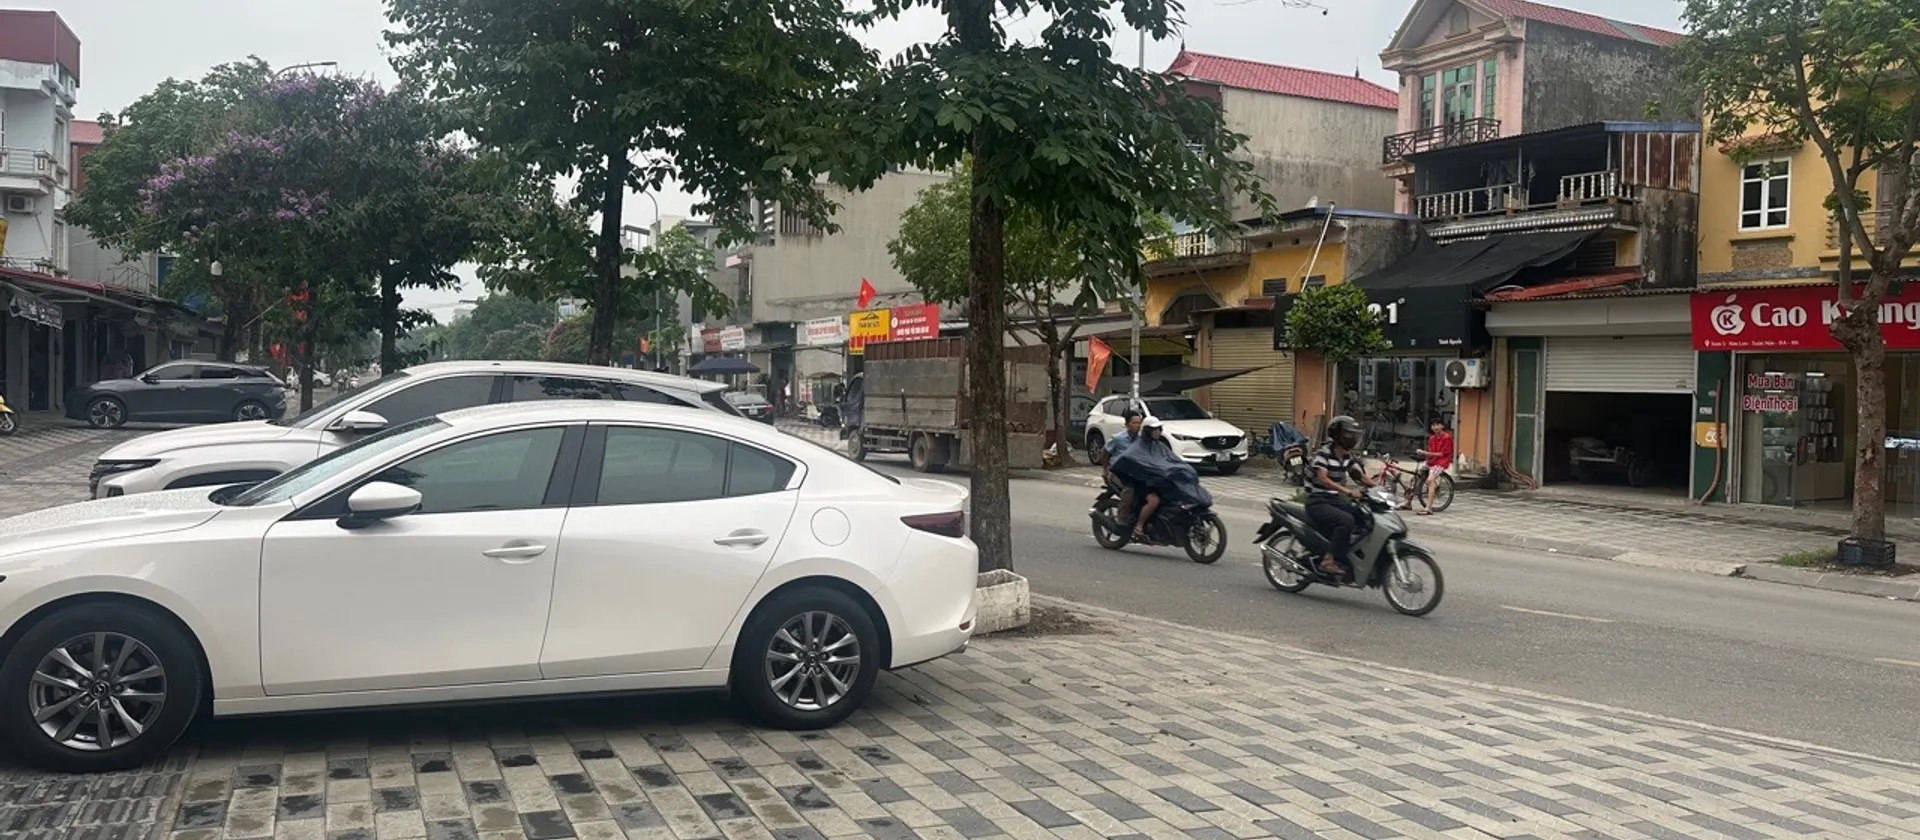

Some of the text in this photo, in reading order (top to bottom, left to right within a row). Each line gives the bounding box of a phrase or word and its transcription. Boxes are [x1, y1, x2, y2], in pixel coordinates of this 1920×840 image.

[1751, 300, 1920, 330] Cao Kng
[1748, 374, 1771, 388] Mua
